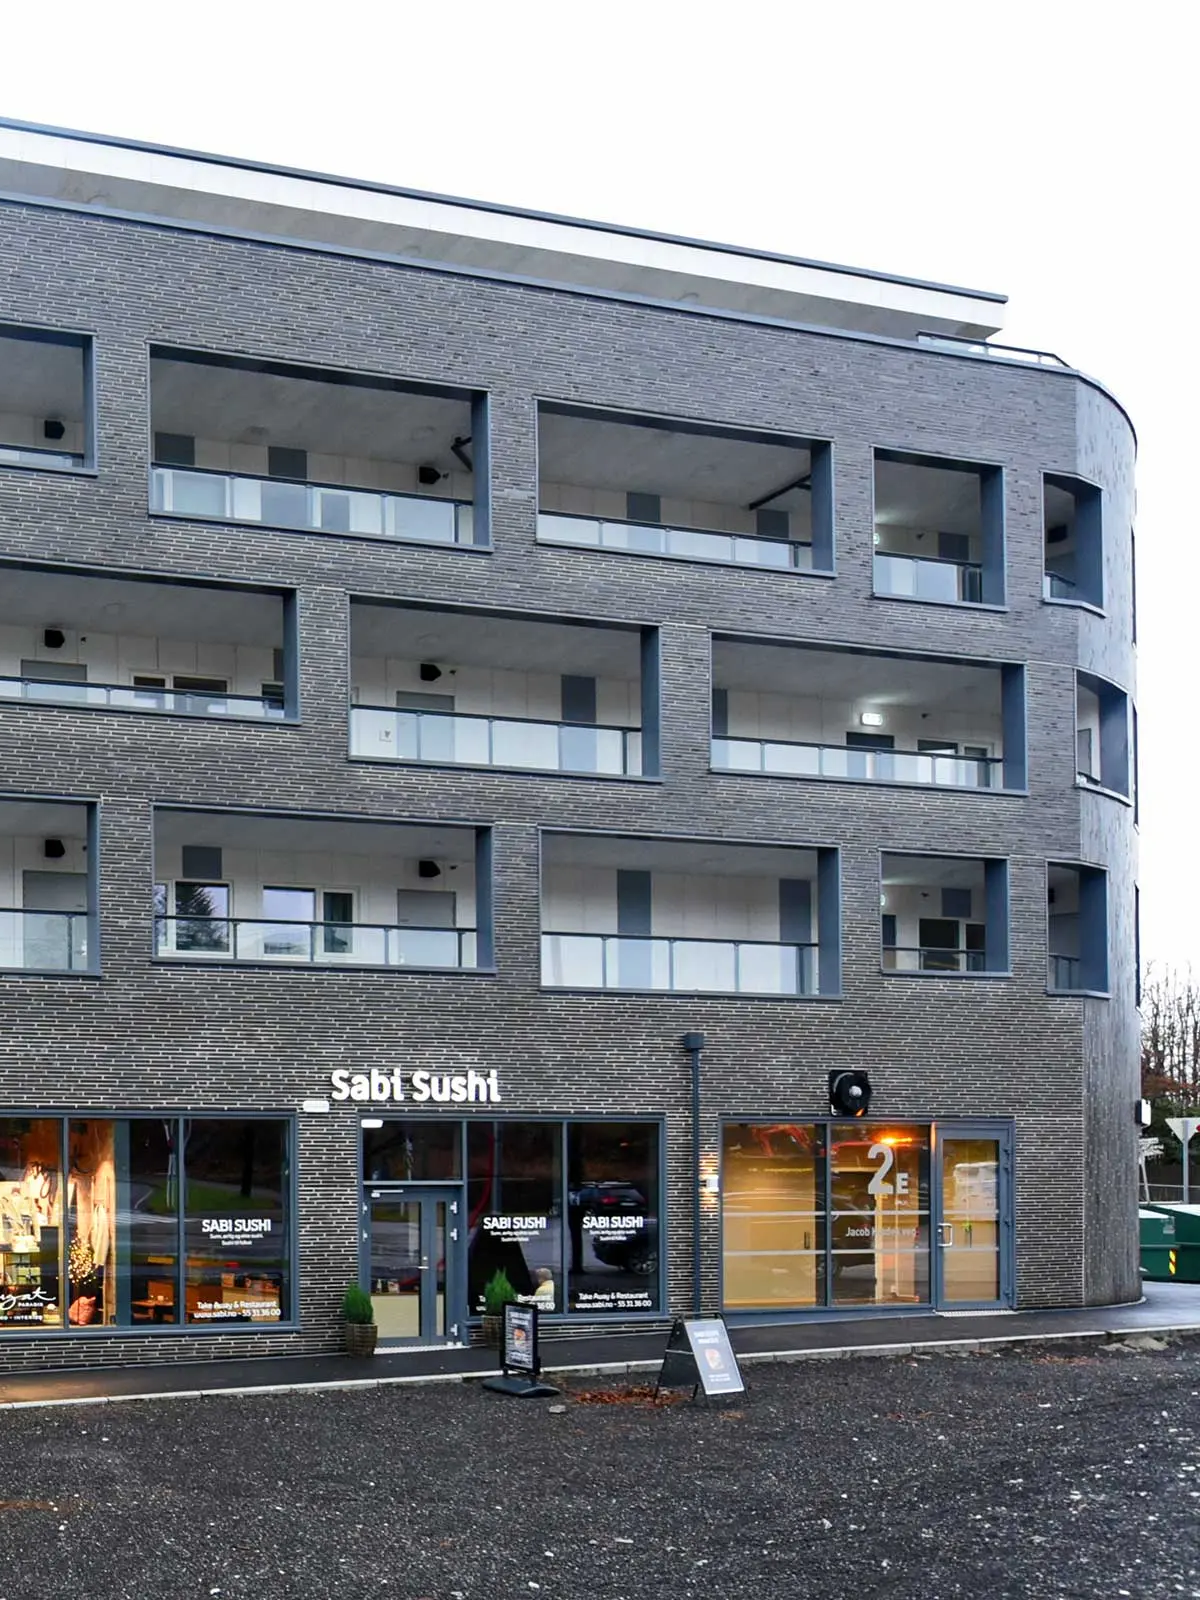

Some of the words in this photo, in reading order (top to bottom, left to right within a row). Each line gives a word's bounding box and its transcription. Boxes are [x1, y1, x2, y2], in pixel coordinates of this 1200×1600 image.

[331, 1068, 404, 1101] Sabi
[412, 1070, 501, 1102] Sushi
[202, 1219, 233, 1232] SABI
[234, 1219, 271, 1232] SUSHI
[483, 1216, 511, 1229] SABI
[512, 1216, 547, 1229] SUSHI
[582, 1216, 609, 1228] SABI
[610, 1216, 644, 1228] SUSHI
[846, 1227, 870, 1237] Jacob
[593, 1292, 610, 1301] Away
[197, 1301, 212, 1309] Take
[213, 1301, 233, 1310] Away
[233, 1301, 239, 1309] &
[240, 1300, 277, 1308] Restaurant
[270, 1308, 281, 1316] 00
